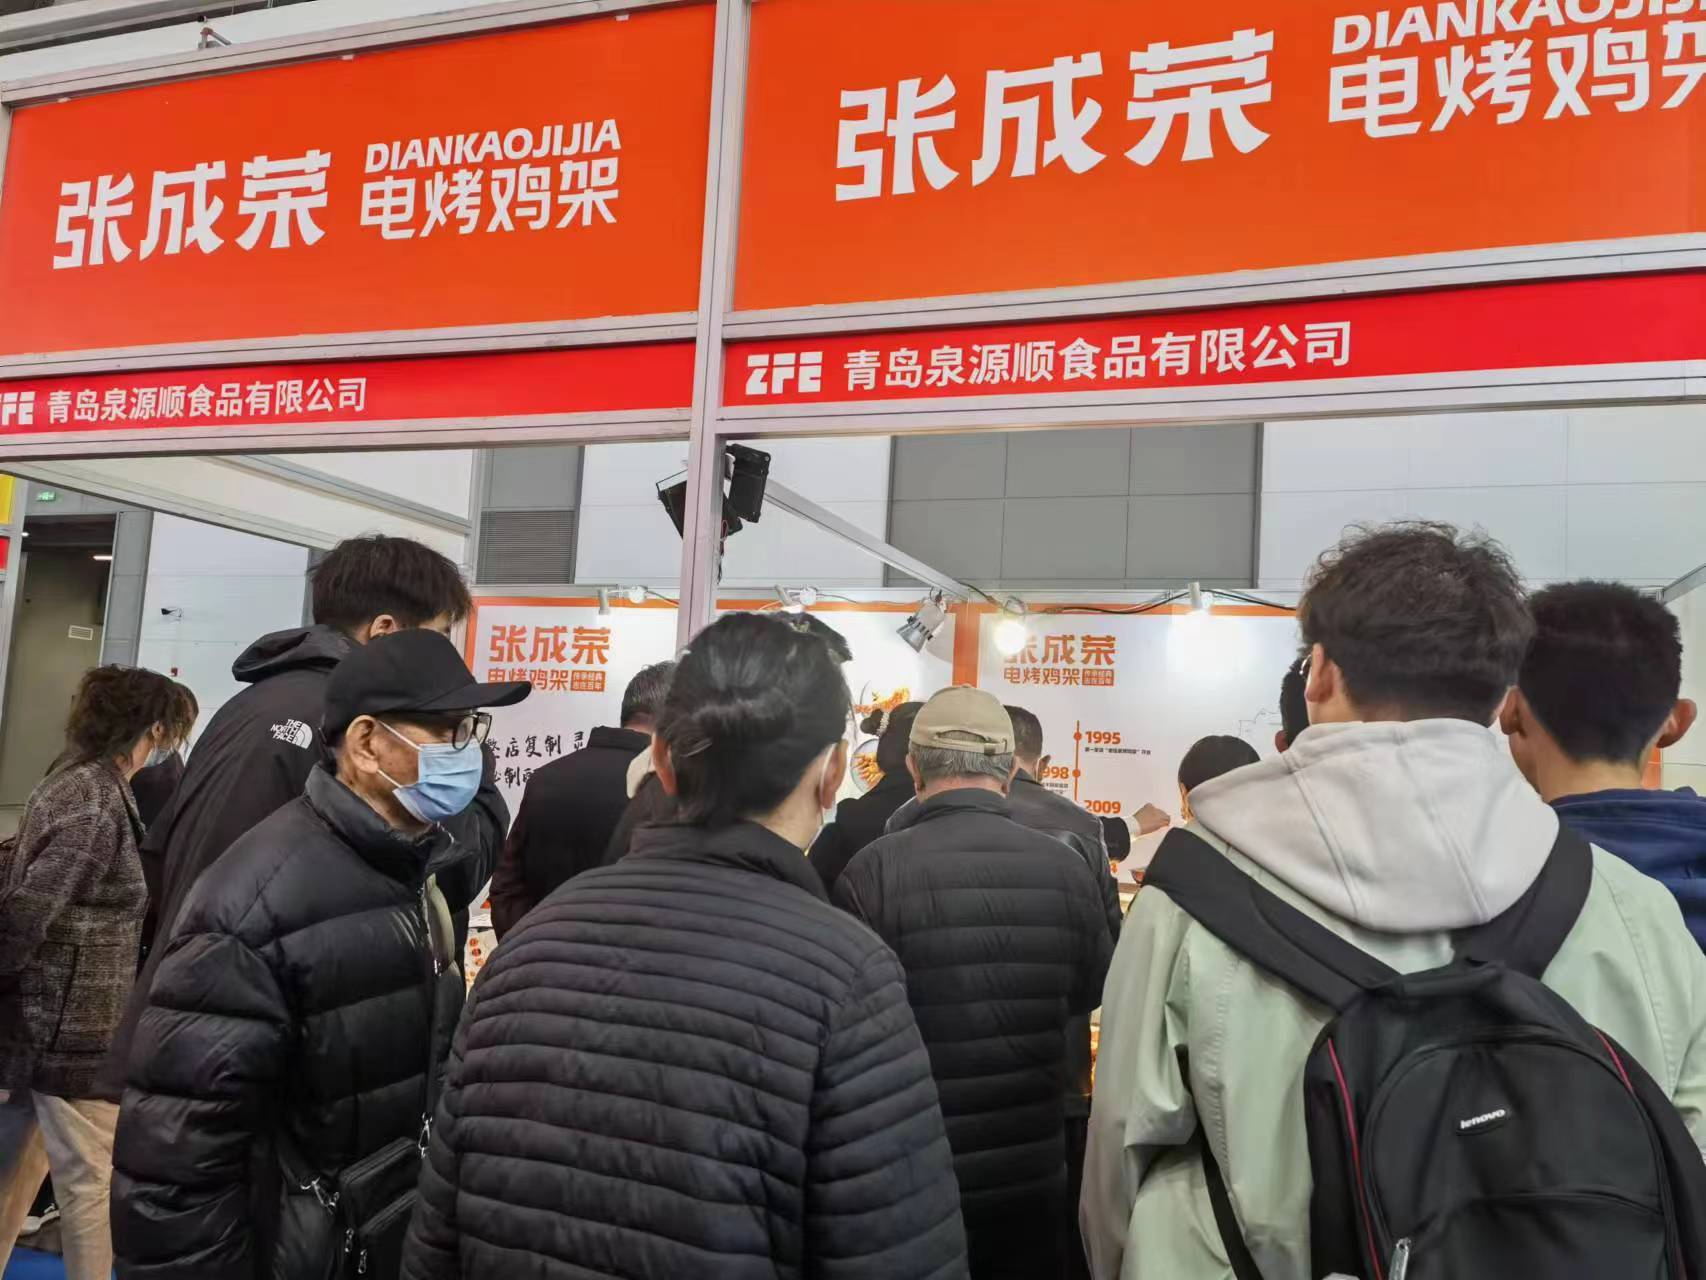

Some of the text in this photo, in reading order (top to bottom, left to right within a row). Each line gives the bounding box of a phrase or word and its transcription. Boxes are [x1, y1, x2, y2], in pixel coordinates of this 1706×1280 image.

[1332, 0, 1706, 54] DIANKAO
[836, 29, 1275, 201] 张成荣
[364, 118, 622, 174] DIANKAOJIJIA
[53, 149, 331, 269] 张成荣
[360, 157, 620, 240] 电烤鸡架
[843, 320, 1352, 392] 青岛泉源顺食品有限公司
[0, 377, 367, 426] FE 青岛泉源顺食品有限公司
[489, 624, 611, 665] 张成荣
[1003, 667, 1080, 686] 电烤鸡架
[272, 731, 296, 743] FACE
[286, 718, 302, 729] THE
[1085, 731, 1121, 745] 1995
[1041, 766, 1069, 780] 998
[1084, 800, 1121, 815] 2009
[1460, 1108, 1506, 1130] lenovo
